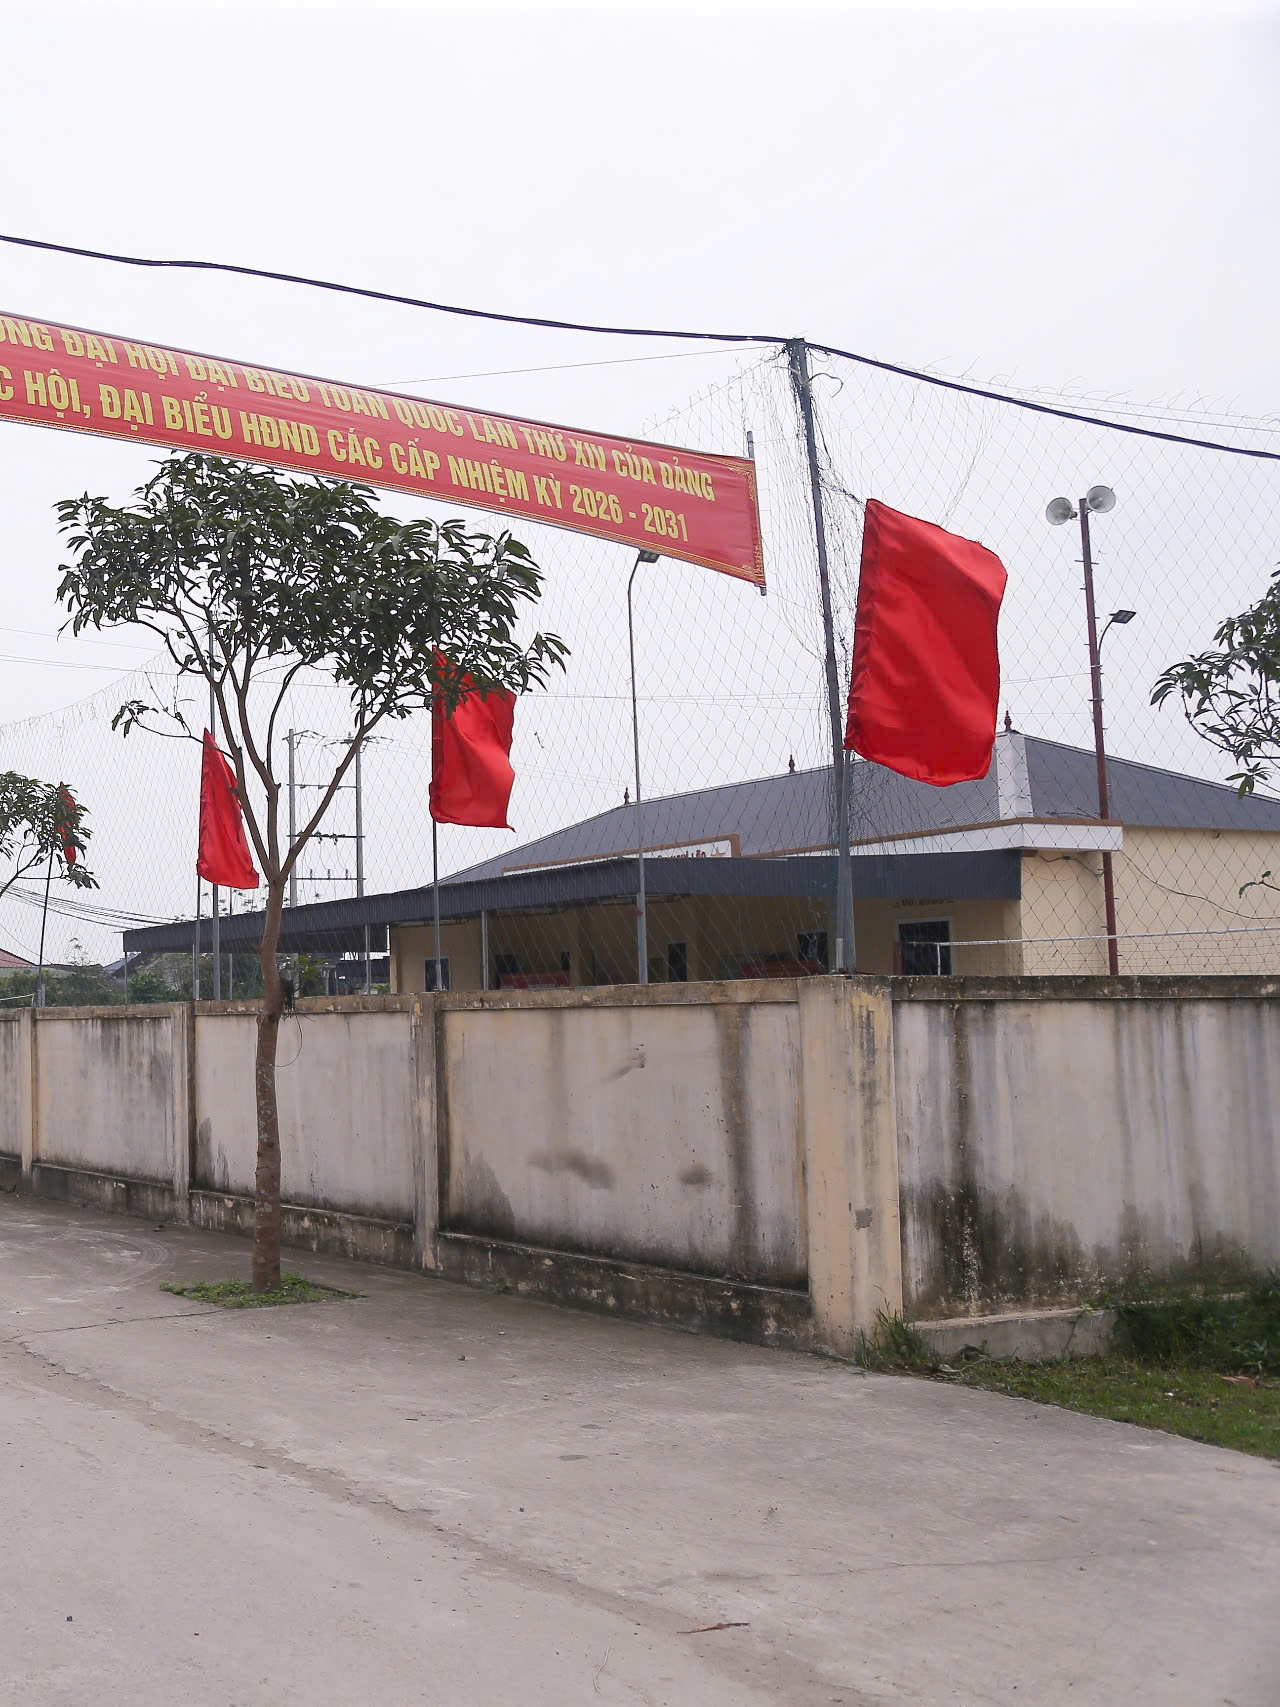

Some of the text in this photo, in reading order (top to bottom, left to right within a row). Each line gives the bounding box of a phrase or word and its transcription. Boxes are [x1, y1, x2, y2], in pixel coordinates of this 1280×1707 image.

[23, 368, 91, 419] HỘI,
[99, 384, 154, 431] ĐẠI
[161, 391, 233, 440] BIỂU
[239, 411, 320, 456] HĐND
[327, 427, 383, 470] CÁC
[388, 437, 441, 481] CẤP
[446, 458, 530, 503] NHIỆM
[533, 472, 563, 509] KỲ
[570, 484, 624, 524] 2026
[628, 511, 637, 520] -
[641, 503, 688, 541] 2031
[61, 329, 118, 368] ĐẠI
[183, 355, 238, 391] ĐẠI
[568, 438, 608, 473] XIV
[612, 444, 658, 486] CỦA
[657, 456, 716, 502] ĐẢNG
